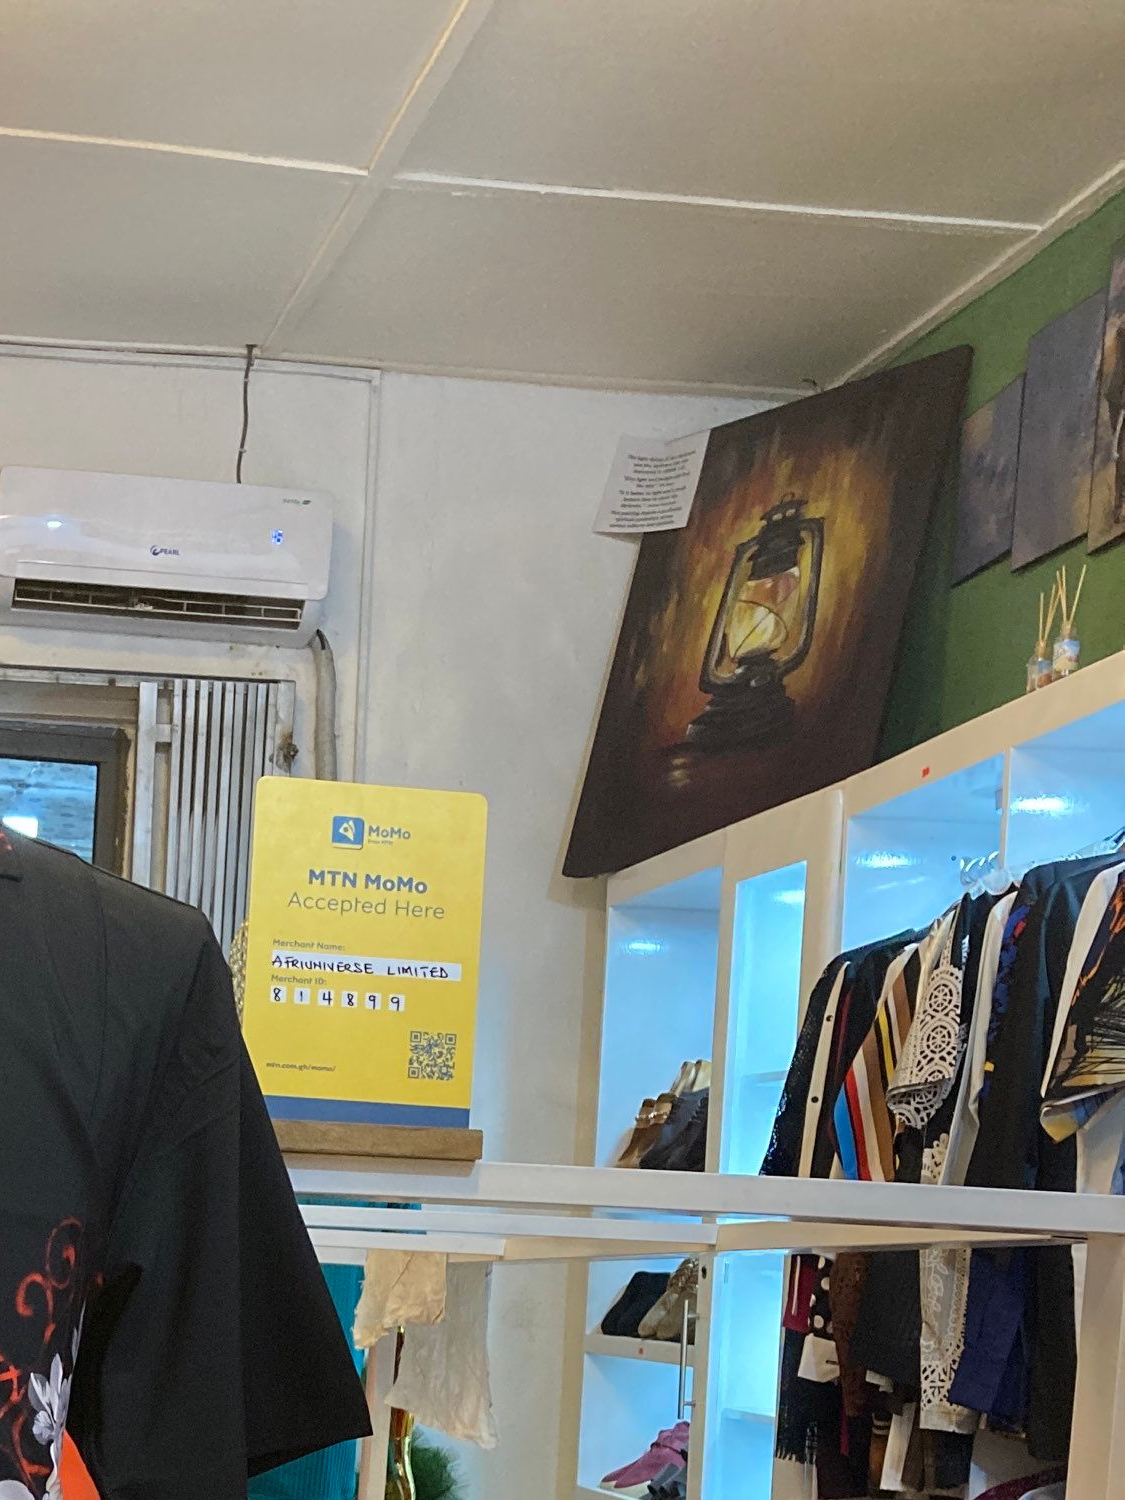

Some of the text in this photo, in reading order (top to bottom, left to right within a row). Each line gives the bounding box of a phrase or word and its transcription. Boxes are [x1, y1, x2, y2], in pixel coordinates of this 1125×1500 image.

[368, 825, 411, 840] MoMo
[308, 869, 428, 894] MTN MoMo
[288, 892, 445, 919] Accepted Here
[273, 939, 345, 951] Merchant Name:
[271, 955, 449, 979] AFRIUNIVERSE LIMITED
[271, 974, 327, 986] Merchant ID:
